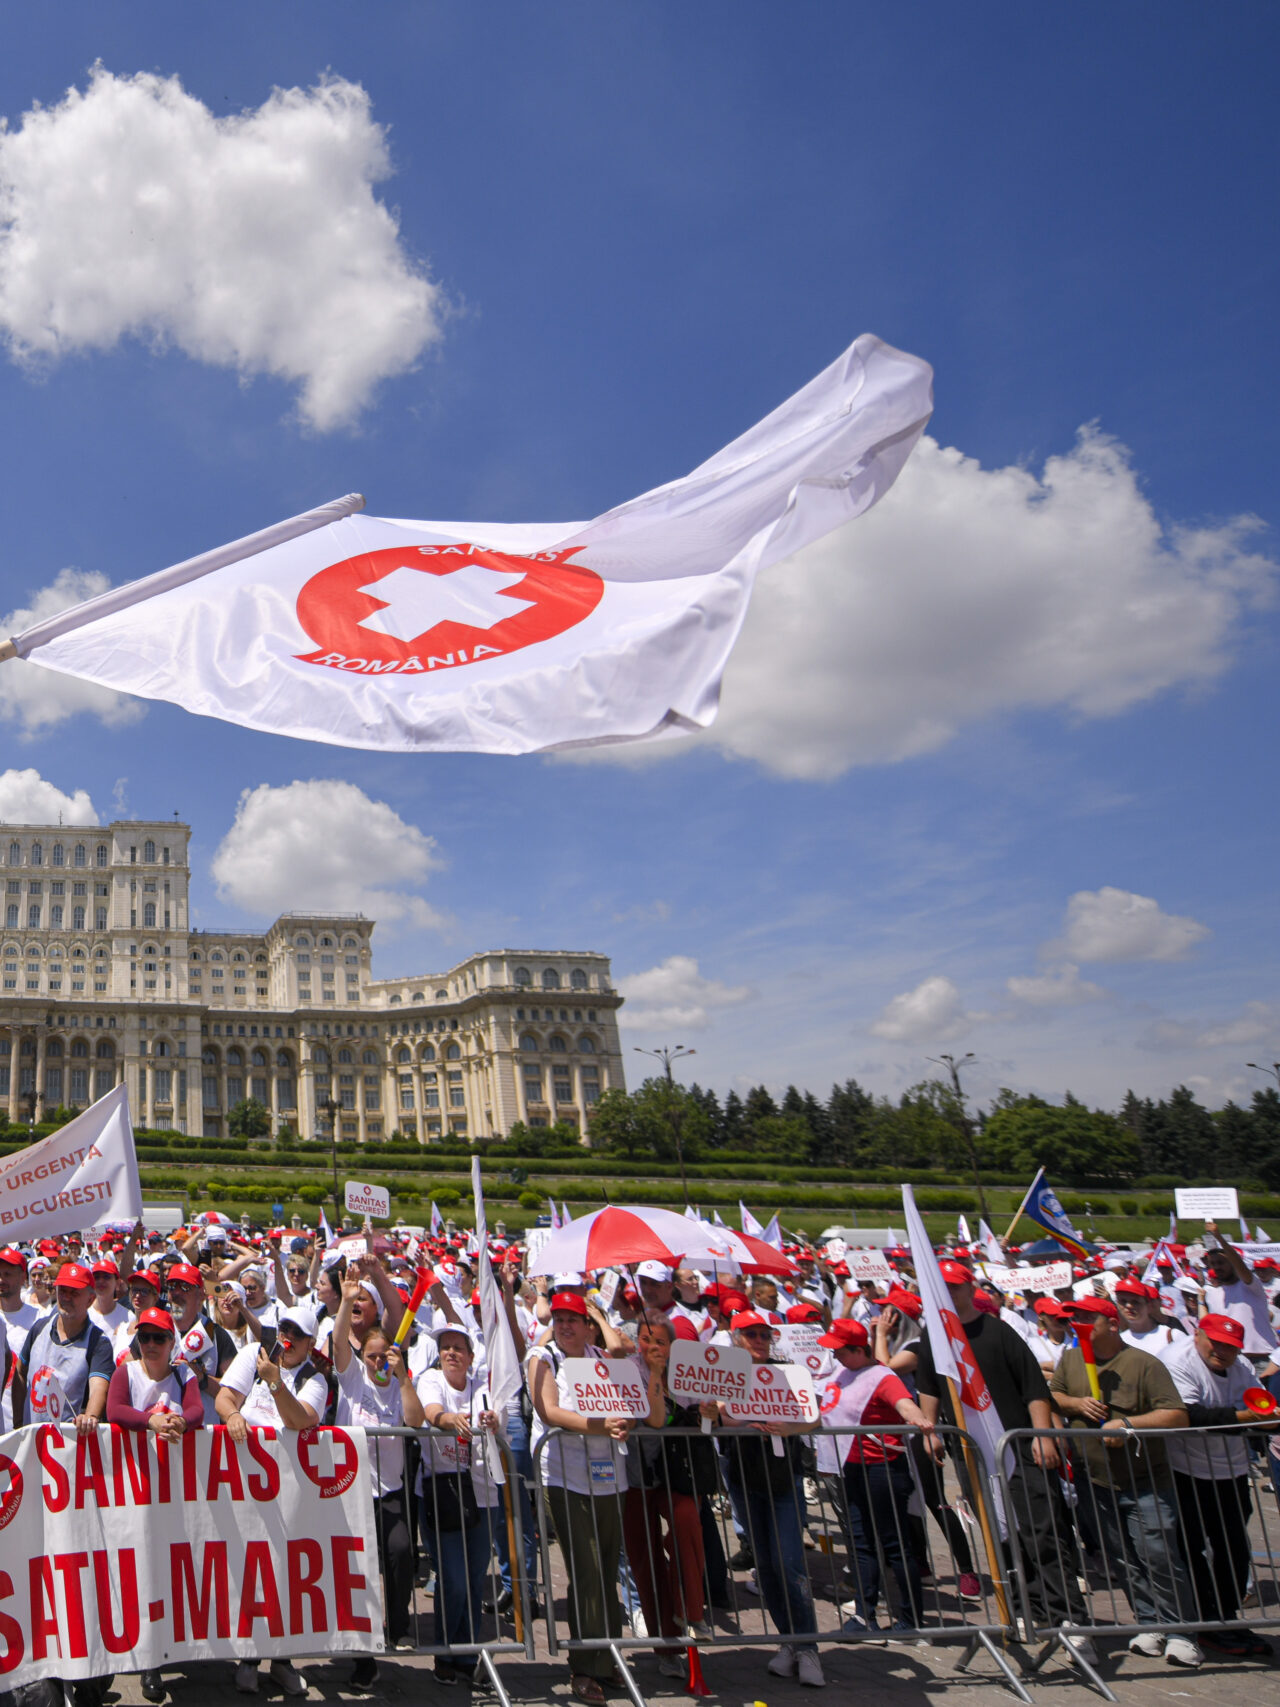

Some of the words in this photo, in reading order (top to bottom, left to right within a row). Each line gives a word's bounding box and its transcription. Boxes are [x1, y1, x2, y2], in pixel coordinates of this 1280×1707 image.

[313, 645, 503, 673] ROMÂNIA
[7, 1144, 103, 1190] URGENȚA
[0, 1181, 113, 1225] BUCURESTI
[349, 1194, 386, 1208] SANITAS
[349, 1202, 387, 1216] BUCUREȘTI
[676, 1363, 745, 1386] SANITAS
[574, 1383, 641, 1399] SANITAS
[674, 1379, 745, 1401] BUCUREȘTI
[578, 1400, 646, 1415] BUCUREȘTI
[731, 1404, 812, 1419] BUCUREȘTI
[35, 1423, 280, 1513] SANITAS
[324, 1470, 355, 1497] ROMÂNIA
